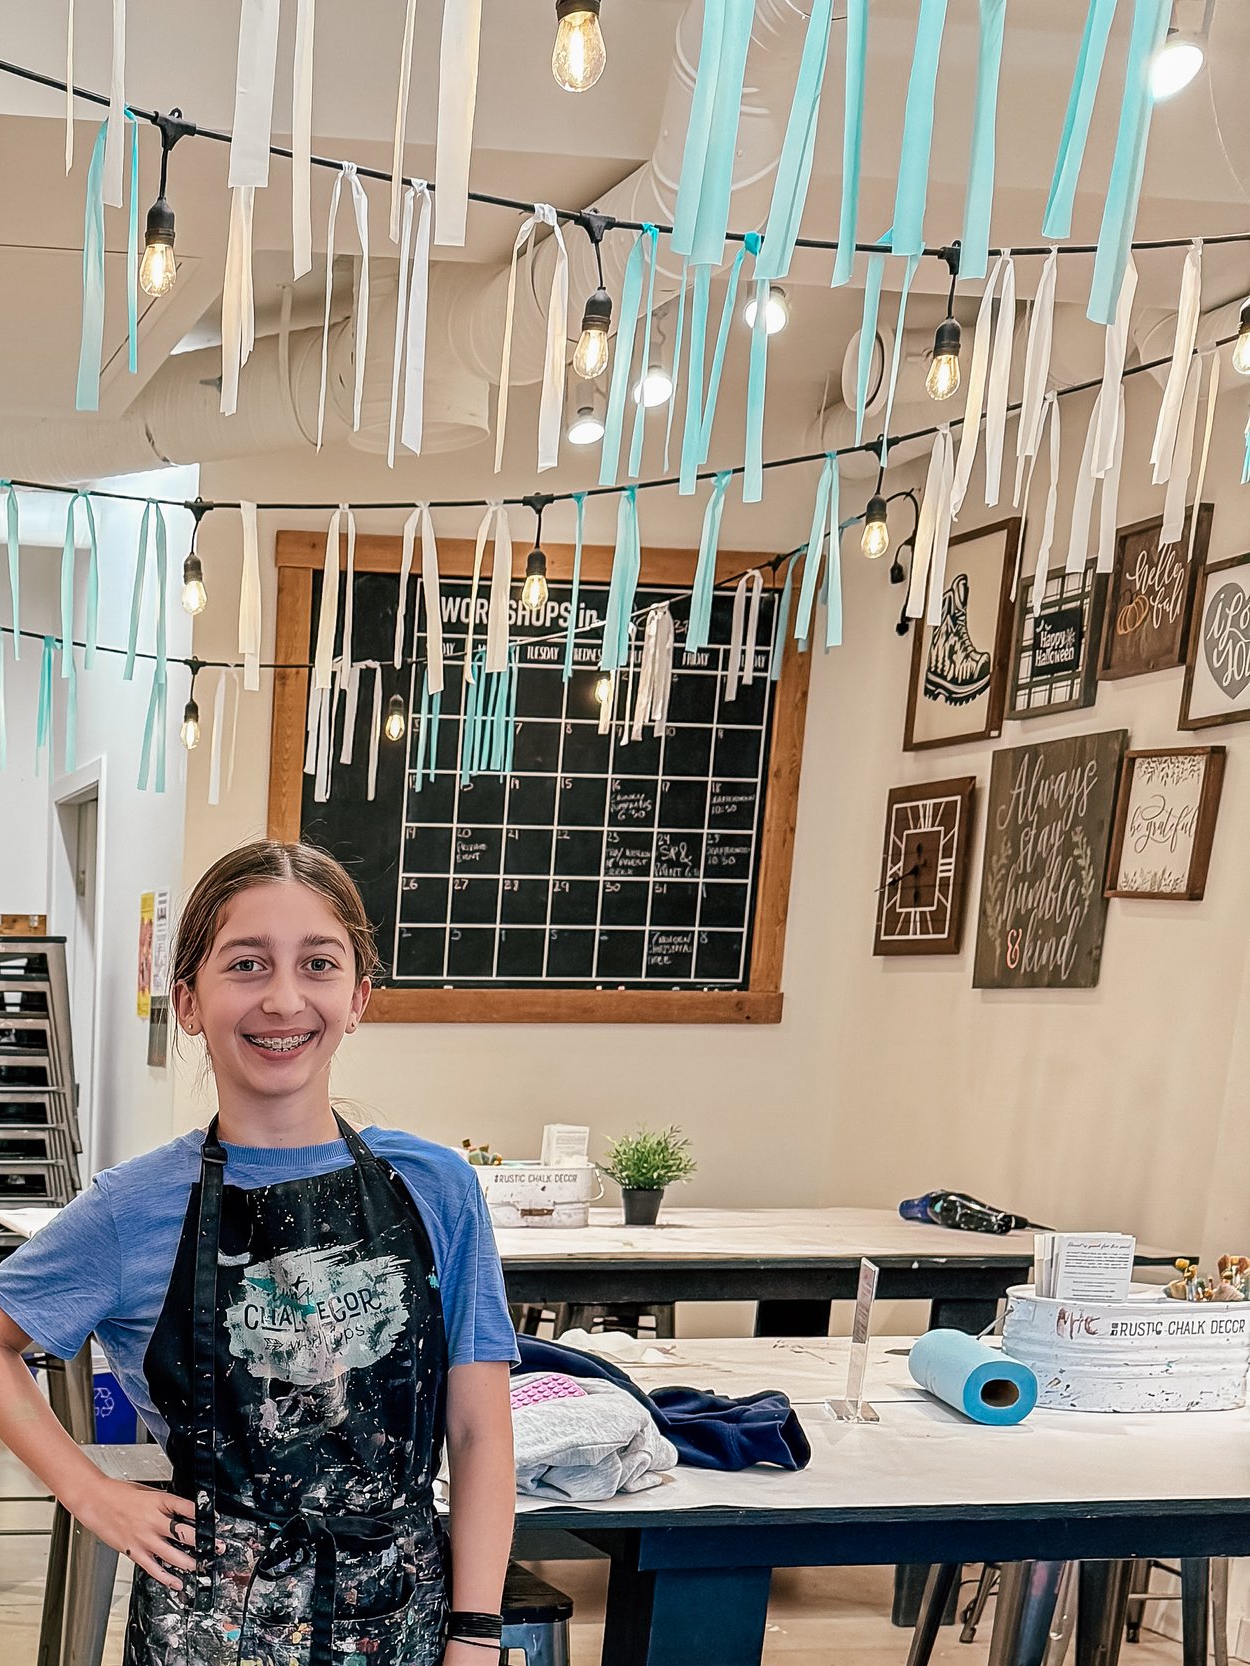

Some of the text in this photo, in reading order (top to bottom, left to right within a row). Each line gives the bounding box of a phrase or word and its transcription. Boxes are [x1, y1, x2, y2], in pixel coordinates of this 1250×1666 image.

[1126, 543, 1183, 594] hello
[1150, 569, 1185, 629] fall
[441, 596, 572, 628] WORSHOPS
[1040, 630, 1066, 648] Happy
[527, 645, 559, 661] TUESDAY
[1035, 647, 1075, 667] Halloween
[997, 753, 1098, 831] Always
[1134, 802, 1199, 853] grateful
[1017, 814, 1065, 878] stay
[402, 878, 419, 890] 26
[454, 880, 468, 890] 27
[554, 881, 570, 892] 29
[605, 882, 621, 892] 30
[654, 884, 667, 893] 31
[1002, 856, 1083, 930] humble
[1006, 907, 1080, 980] & kind
[499, 1174, 578, 1183] RUSTIC CHALK DECOR
[1119, 1322, 1163, 1337] RUSTIC
[1167, 1320, 1206, 1336] CHALK
